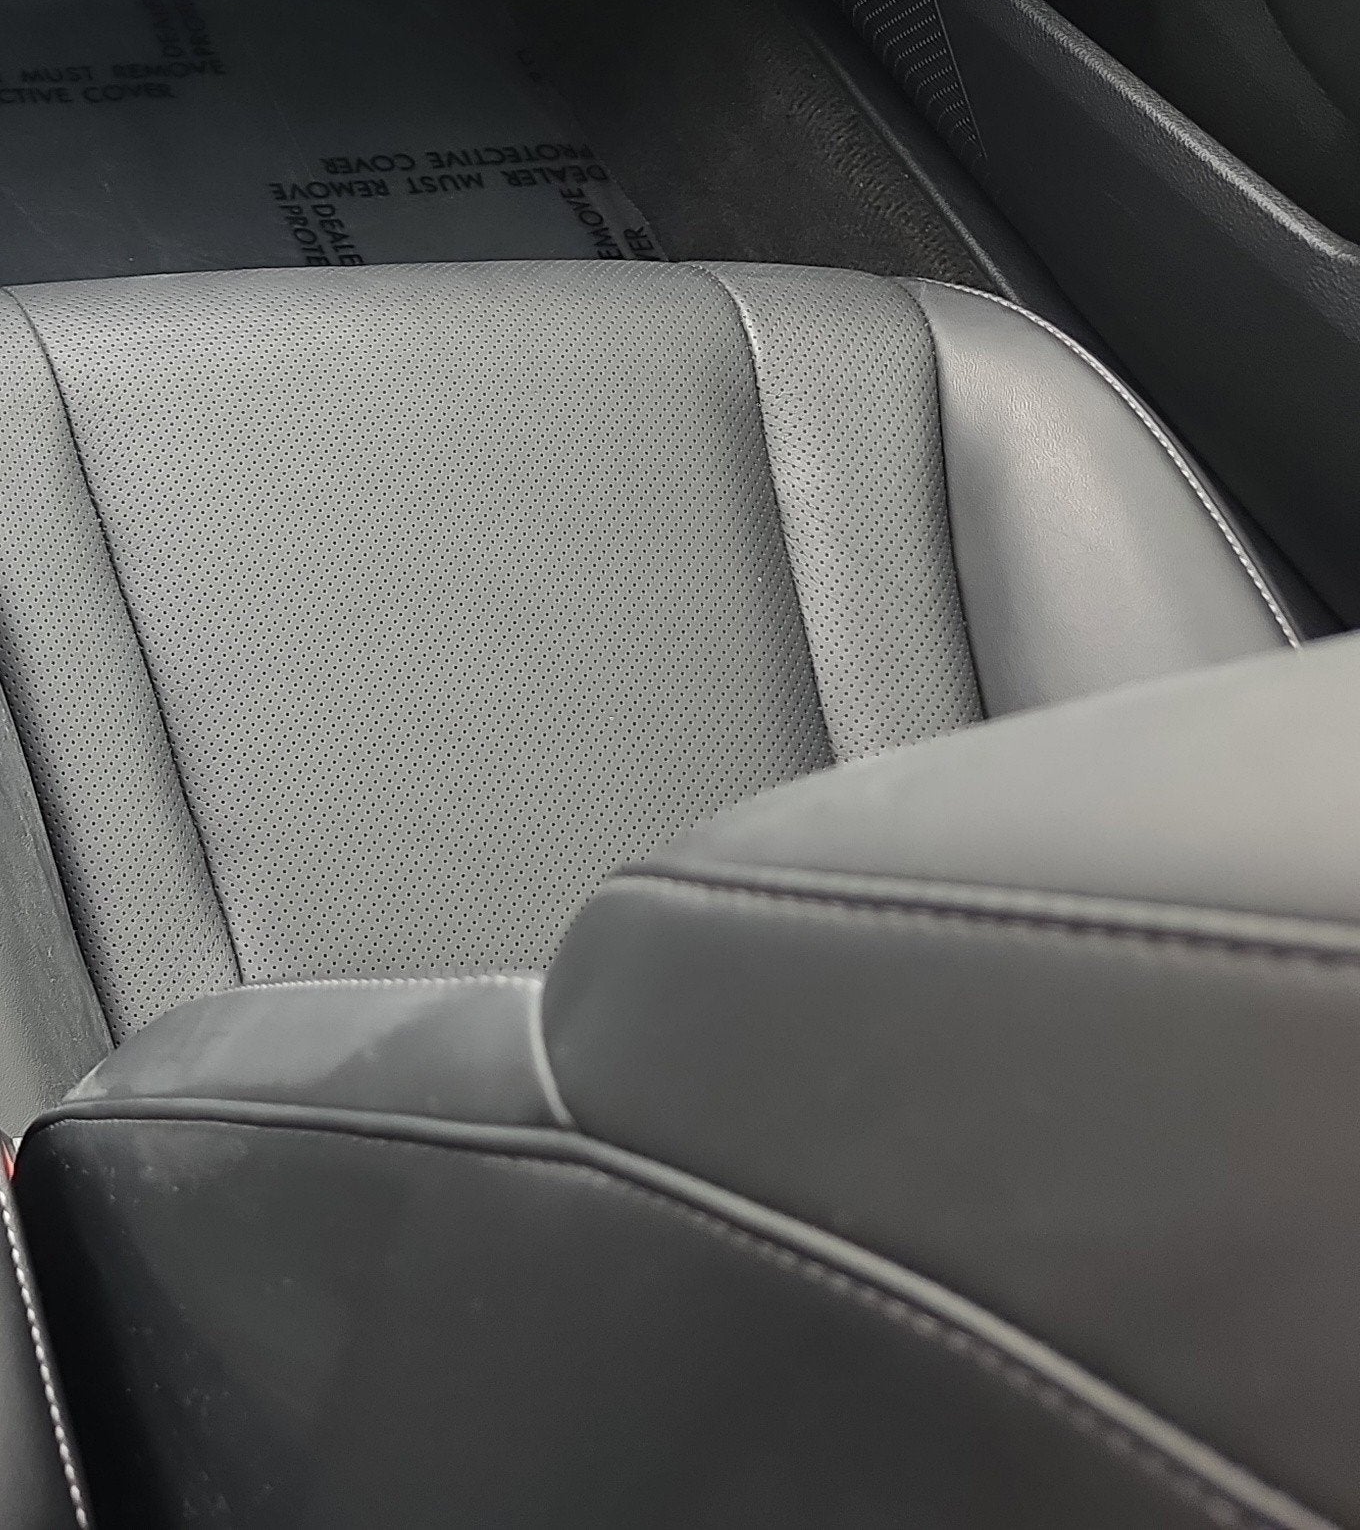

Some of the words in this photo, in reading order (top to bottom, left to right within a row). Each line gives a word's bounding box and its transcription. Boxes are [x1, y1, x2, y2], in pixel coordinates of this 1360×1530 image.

[324, 152, 416, 176] COVER
[426, 142, 595, 170] PROTECTIVE
[406, 172, 485, 196] MUST
[499, 163, 610, 189] DEALER
[268, 178, 389, 202] REMOVE
[310, 203, 364, 265] DEALE
[560, 187, 625, 259] EMOVE
